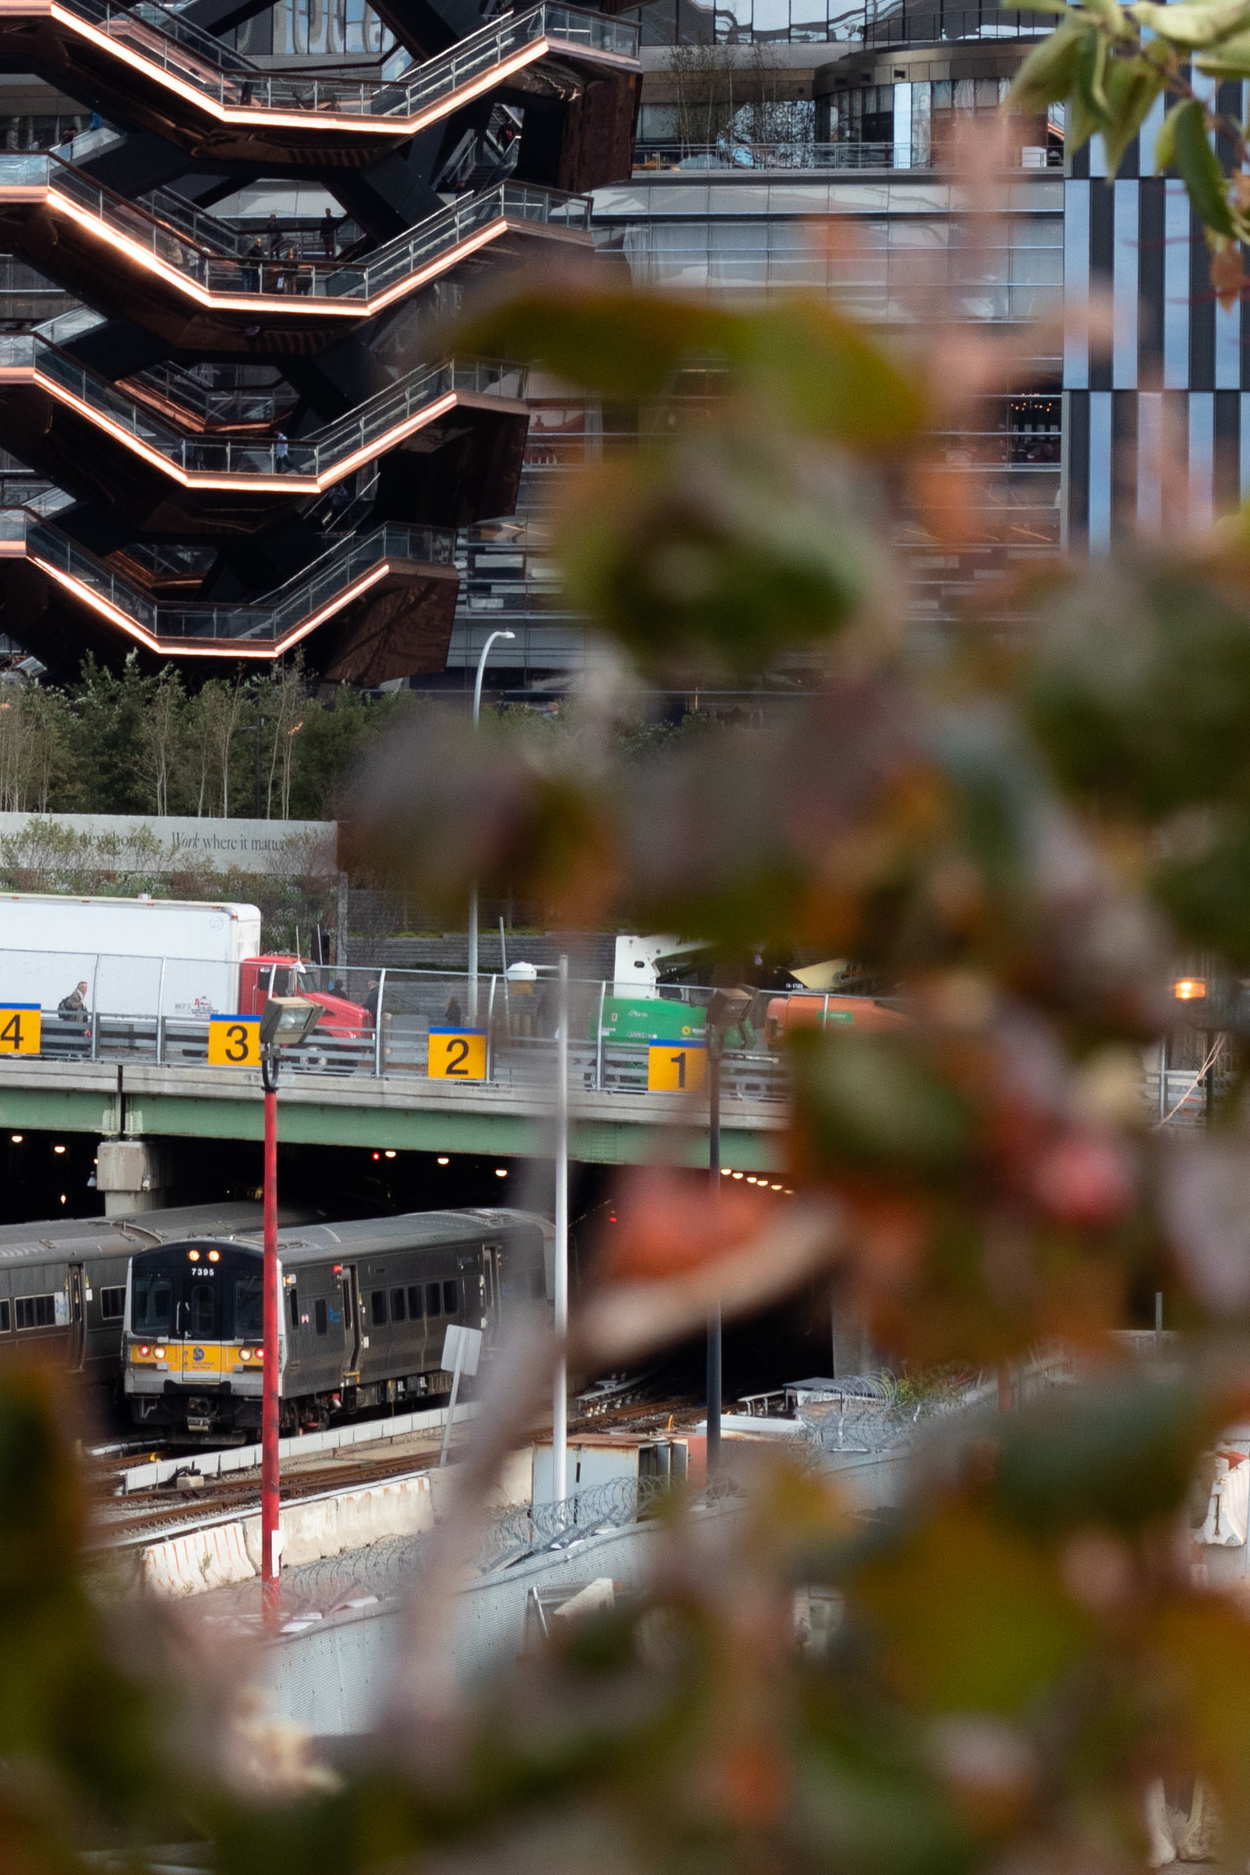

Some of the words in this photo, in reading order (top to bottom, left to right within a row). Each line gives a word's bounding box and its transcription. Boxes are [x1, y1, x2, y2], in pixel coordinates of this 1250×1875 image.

[171, 831, 200, 849] Work
[202, 833, 238, 851] where
[240, 833, 248, 851] it
[0, 1014, 24, 1050] 4
[225, 1025, 249, 1062] 3
[446, 1038, 469, 1075] 2
[671, 1052, 686, 1088] 1
[191, 1267, 215, 1277] 7395
